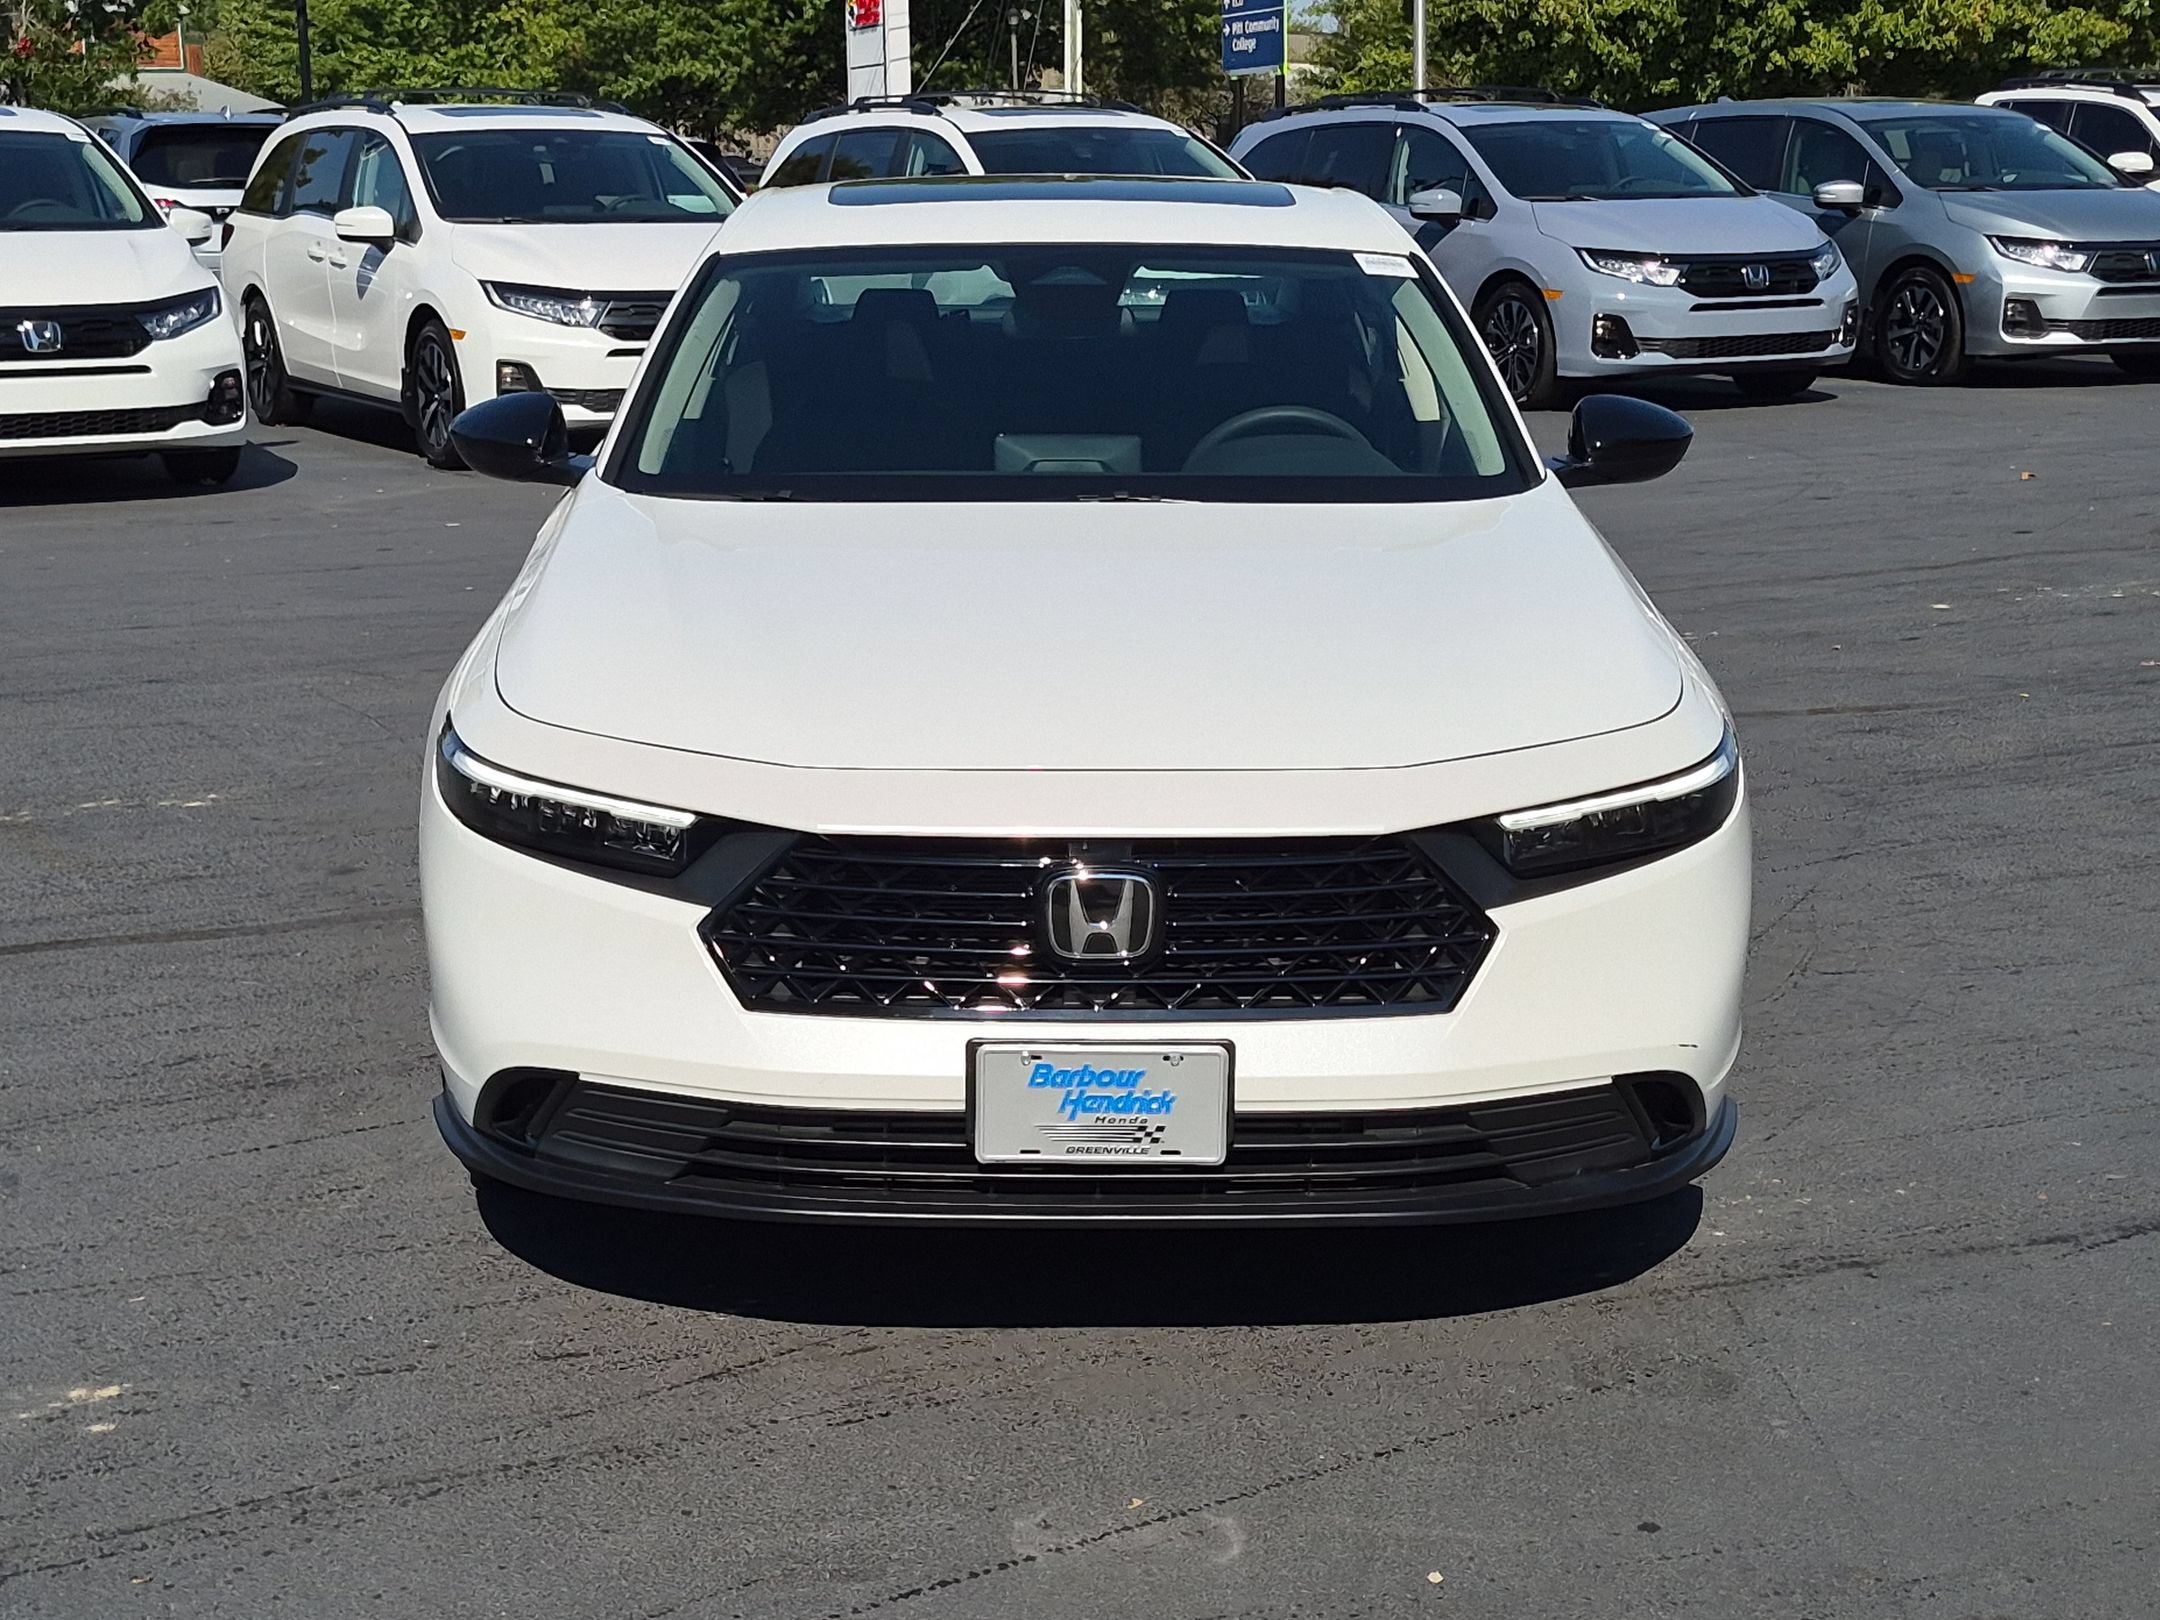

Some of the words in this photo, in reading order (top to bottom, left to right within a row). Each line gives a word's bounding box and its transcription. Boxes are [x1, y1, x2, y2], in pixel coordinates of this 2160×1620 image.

[1245, 16, 1279, 34] Community
[1232, 37, 1257, 53] College
[1028, 1063, 1147, 1088] Barbour
[1057, 1089, 1178, 1121] Hendrick
[1094, 1116, 1148, 1124] Honda
[1065, 1146, 1151, 1155] GREENVILLE
